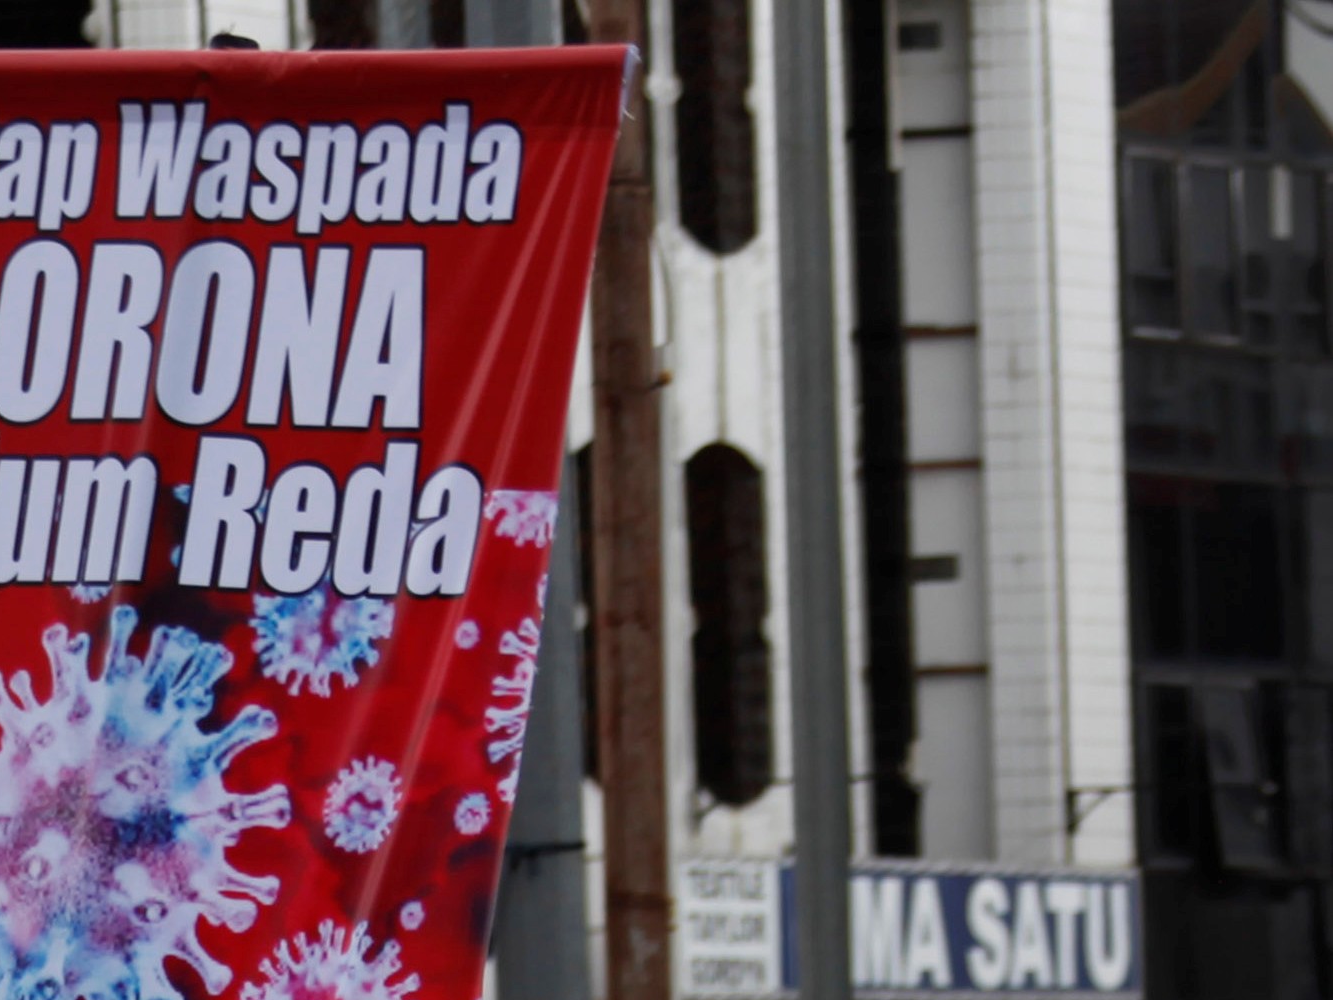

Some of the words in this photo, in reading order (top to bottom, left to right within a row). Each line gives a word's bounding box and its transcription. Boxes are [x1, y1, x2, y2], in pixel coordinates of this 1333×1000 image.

[117, 100, 523, 235] Waspada
[177, 434, 484, 598] Reda
[851, 876, 953, 990] MA
[967, 878, 1131, 991] SATU
